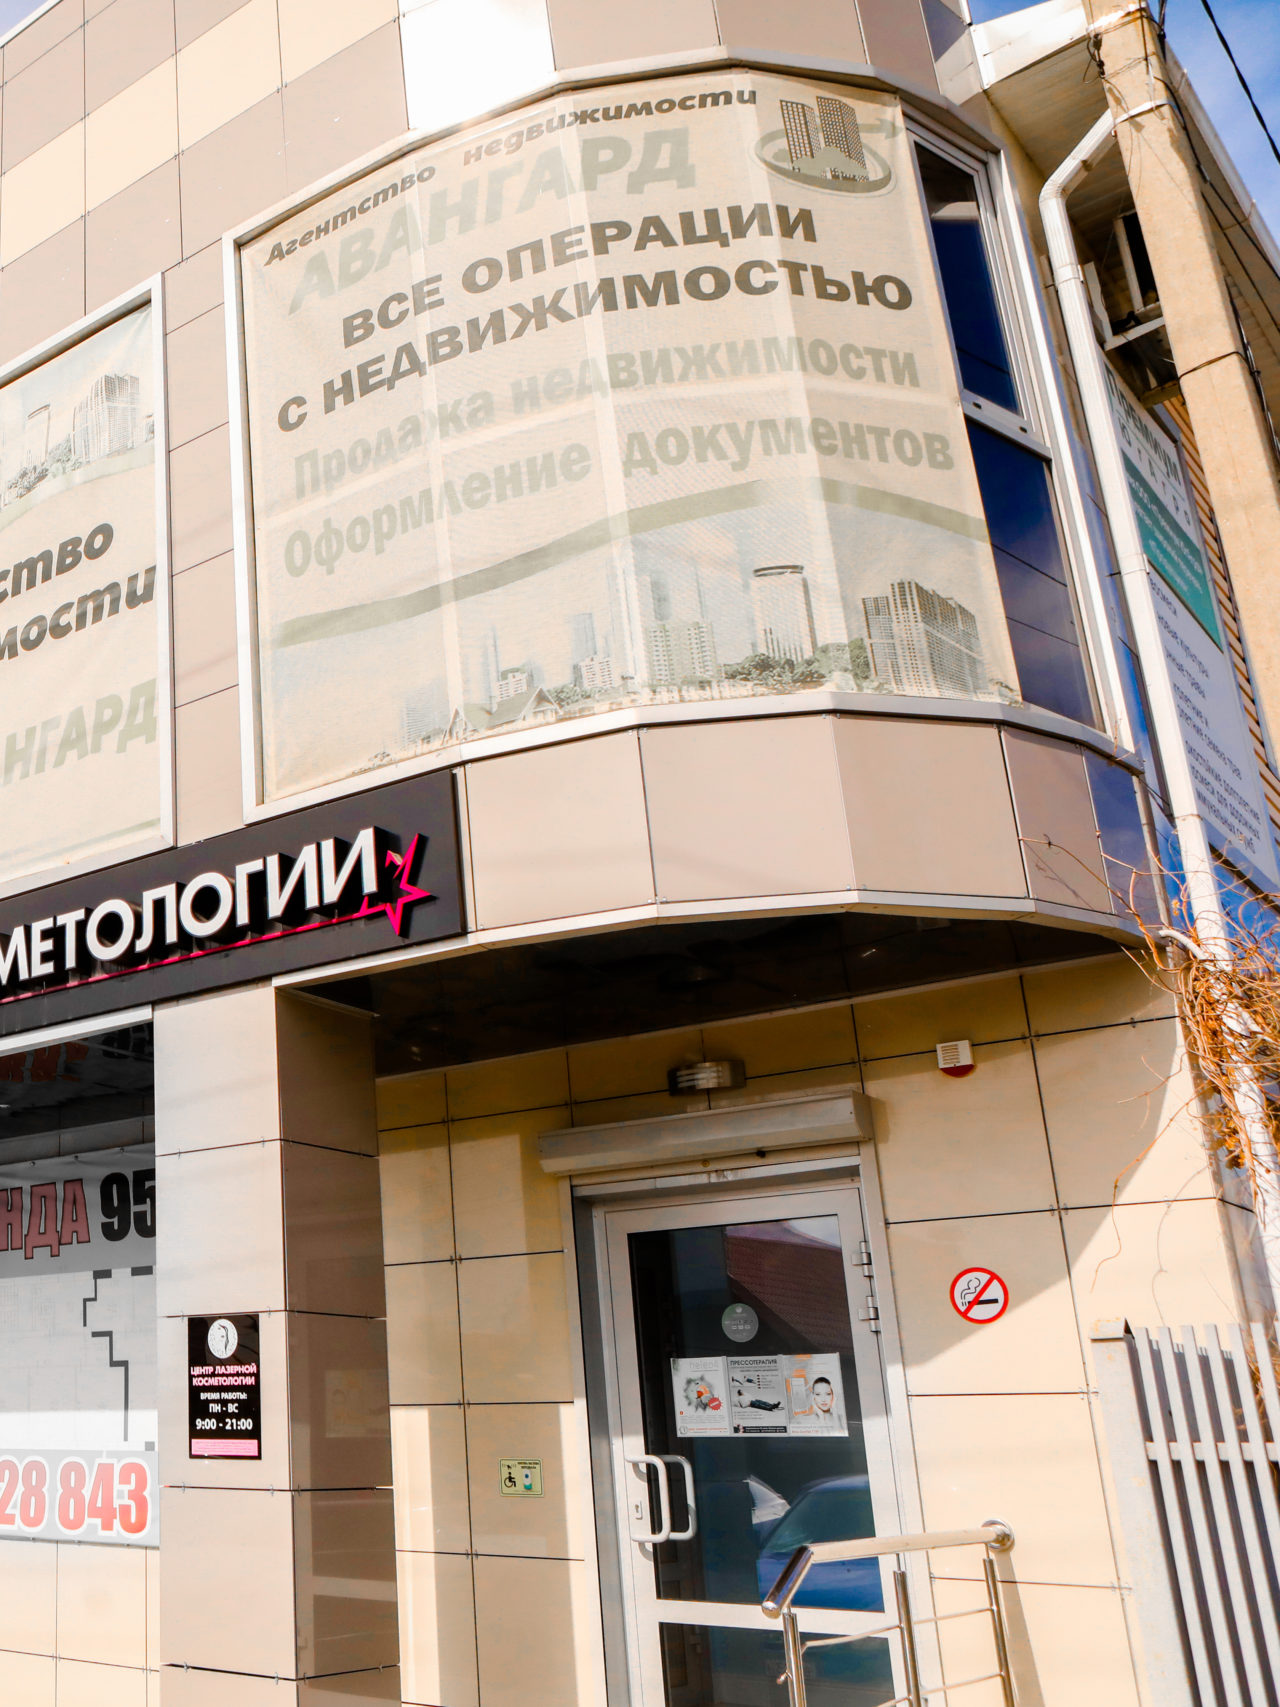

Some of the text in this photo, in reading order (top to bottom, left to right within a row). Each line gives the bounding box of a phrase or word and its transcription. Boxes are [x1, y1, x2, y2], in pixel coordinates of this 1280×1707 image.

[264, 88, 758, 267] Агентство недвижимости
[288, 125, 698, 316] АВАНГАРД
[342, 202, 818, 349] ВСЕ ОПЕРАЦИИ
[322, 259, 913, 416] НЕДВИЖИМОСТЬЮ
[293, 335, 921, 501] Продажа недвижимости
[284, 416, 956, 579] Оформление документов
[99, 1167, 156, 1243] 95
[190, 1363, 257, 1376] ЦЕНТР ЛАЗЕРНОЙ
[192, 1376, 255, 1387] КОСМЕТОЛОГИИ
[200, 1392, 220, 1400] ВРЕМЯ
[730, 1358, 778, 1367] ПРЕССОТЕРАПИЯ
[195, 1418, 217, 1430] 9:00
[225, 1418, 253, 1430] 21:00
[209, 1403, 221, 1413] ПН
[227, 1403, 239, 1413] ВС
[57, 1459, 150, 1534] 843
